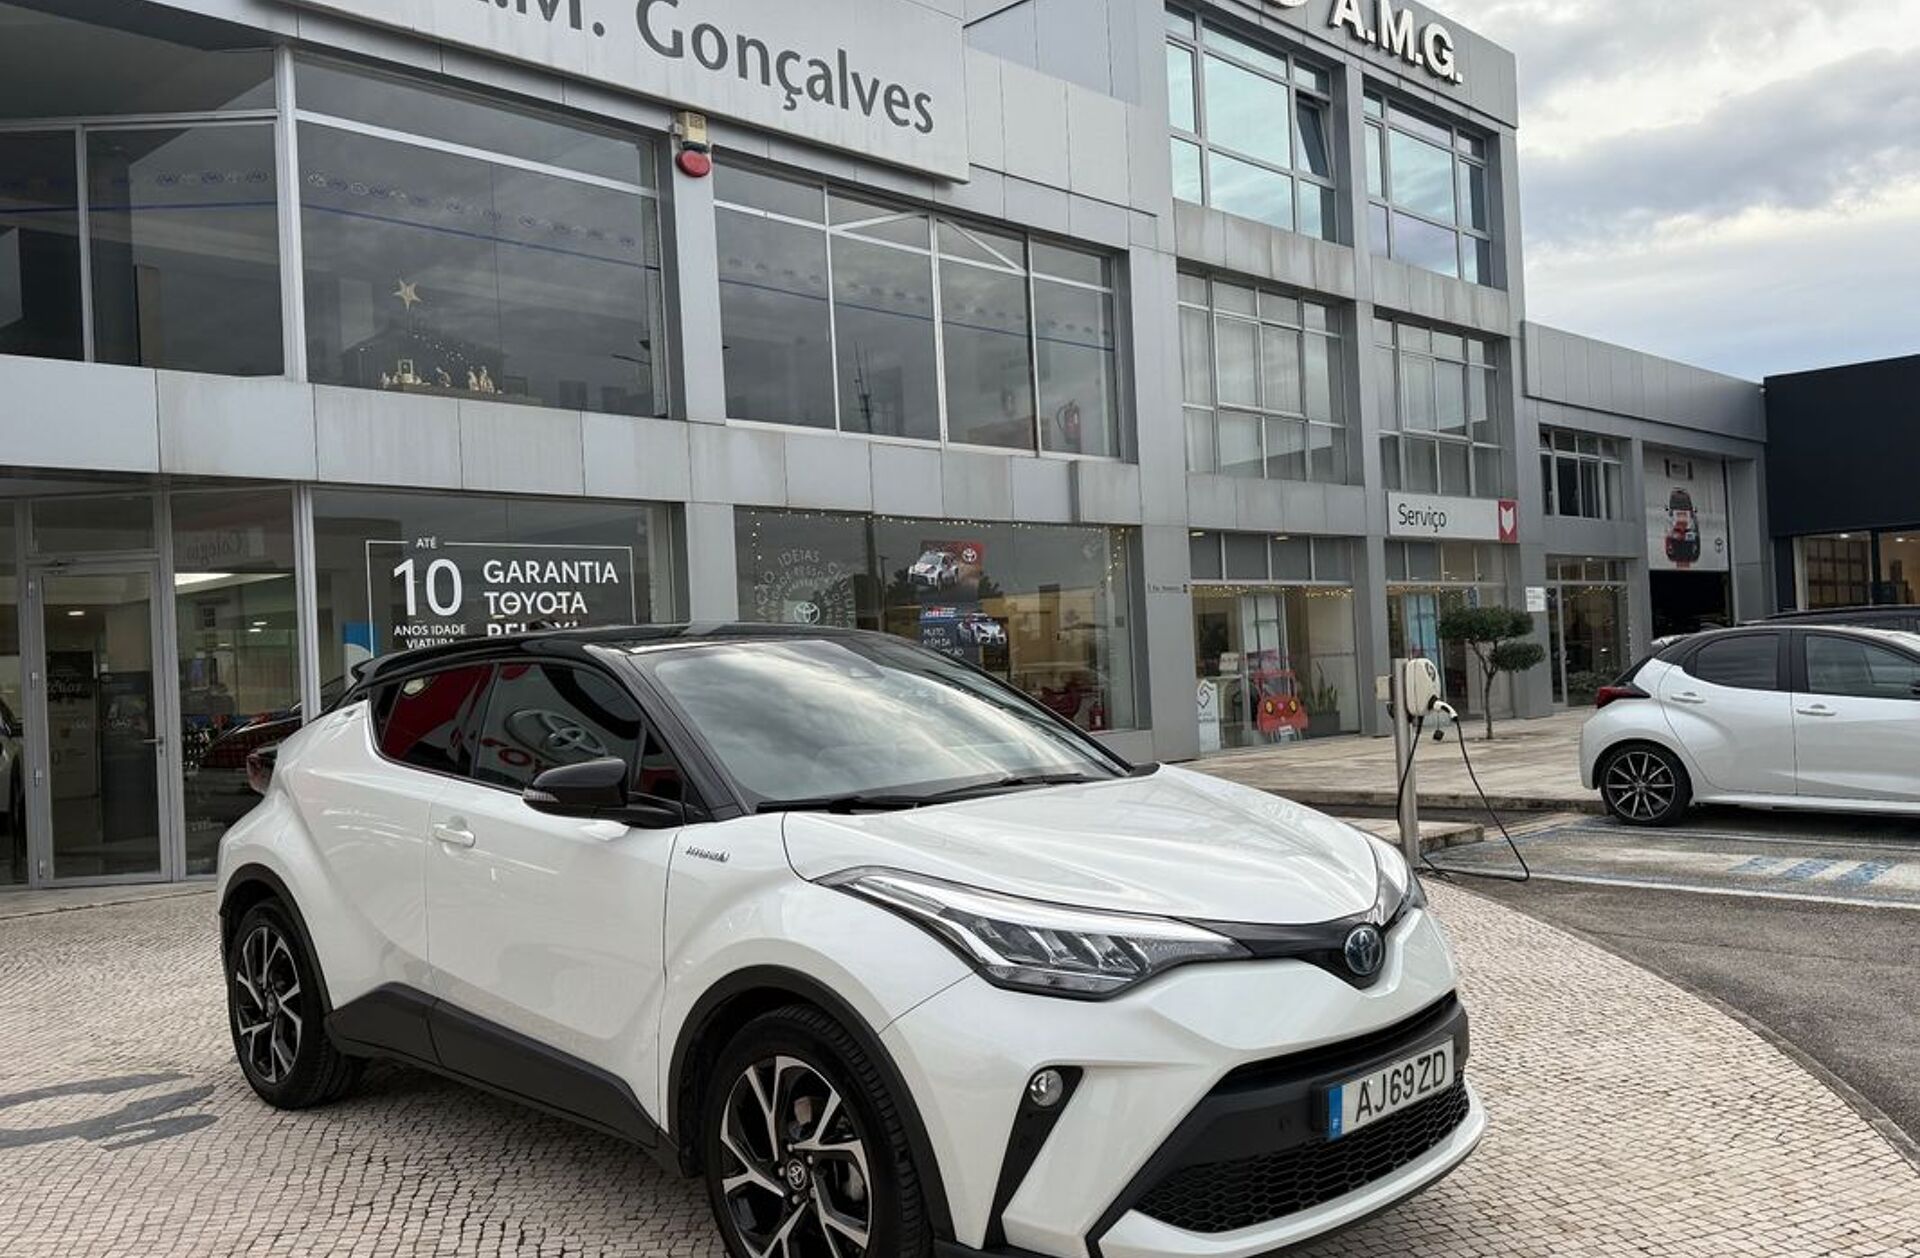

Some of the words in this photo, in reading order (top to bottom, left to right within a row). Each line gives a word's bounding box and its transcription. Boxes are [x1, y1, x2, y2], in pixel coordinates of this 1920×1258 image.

[1329, 0, 1463, 83] A.M.G.
[636, 0, 934, 133] Gonçalves
[1397, 503, 1447, 532] Serviço
[415, 537, 437, 549] ATÉ
[778, 547, 820, 568] IDEIAS
[483, 560, 619, 584] GARANTIA
[393, 558, 462, 616] 10
[484, 591, 588, 615] TOYOTA
[393, 624, 428, 636] ANOS
[430, 623, 467, 636] IDADE
[1355, 1049, 1446, 1122] AJ69ZD
